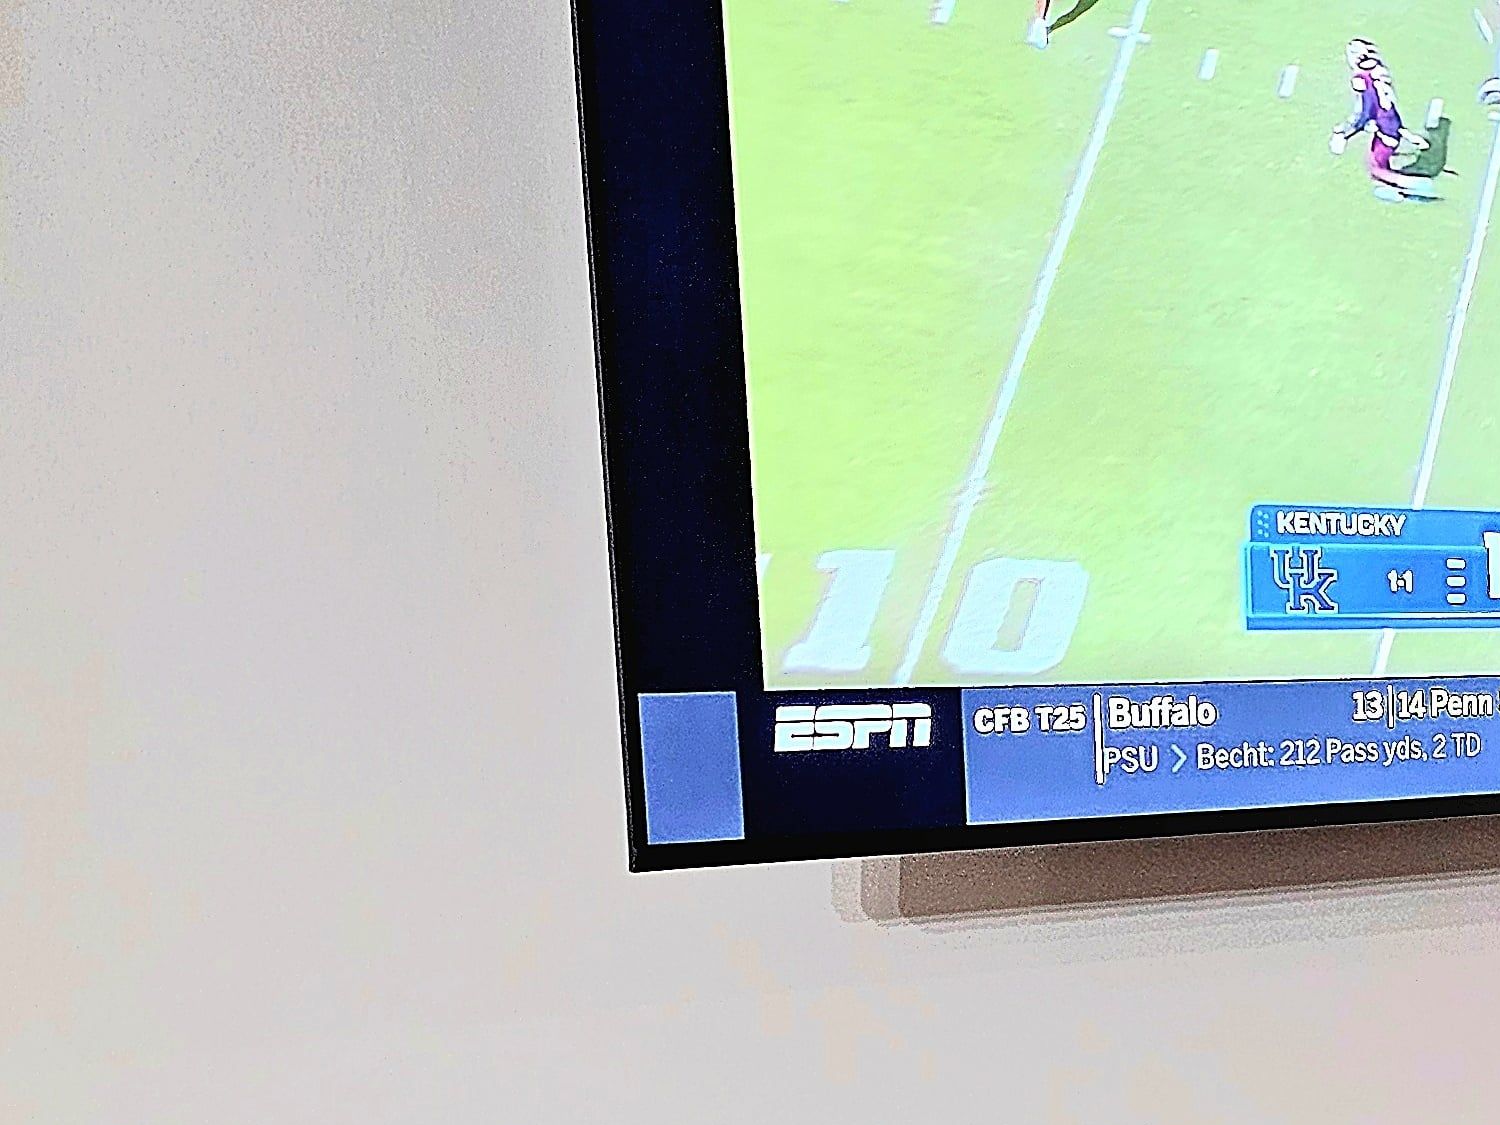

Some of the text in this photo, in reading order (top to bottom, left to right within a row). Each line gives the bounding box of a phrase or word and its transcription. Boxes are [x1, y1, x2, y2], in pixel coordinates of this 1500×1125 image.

[1276, 511, 1406, 536] KENTUCKY
[972, 704, 1087, 735] CFB T25
[1108, 691, 1385, 729] Buffalo 13
[1397, 690, 1427, 720] 14
[1430, 688, 1493, 718] Penn
[773, 702, 933, 753] ESPN
[1104, 731, 1481, 775] PSU Becht: 212 Pass yds, 2 TD
